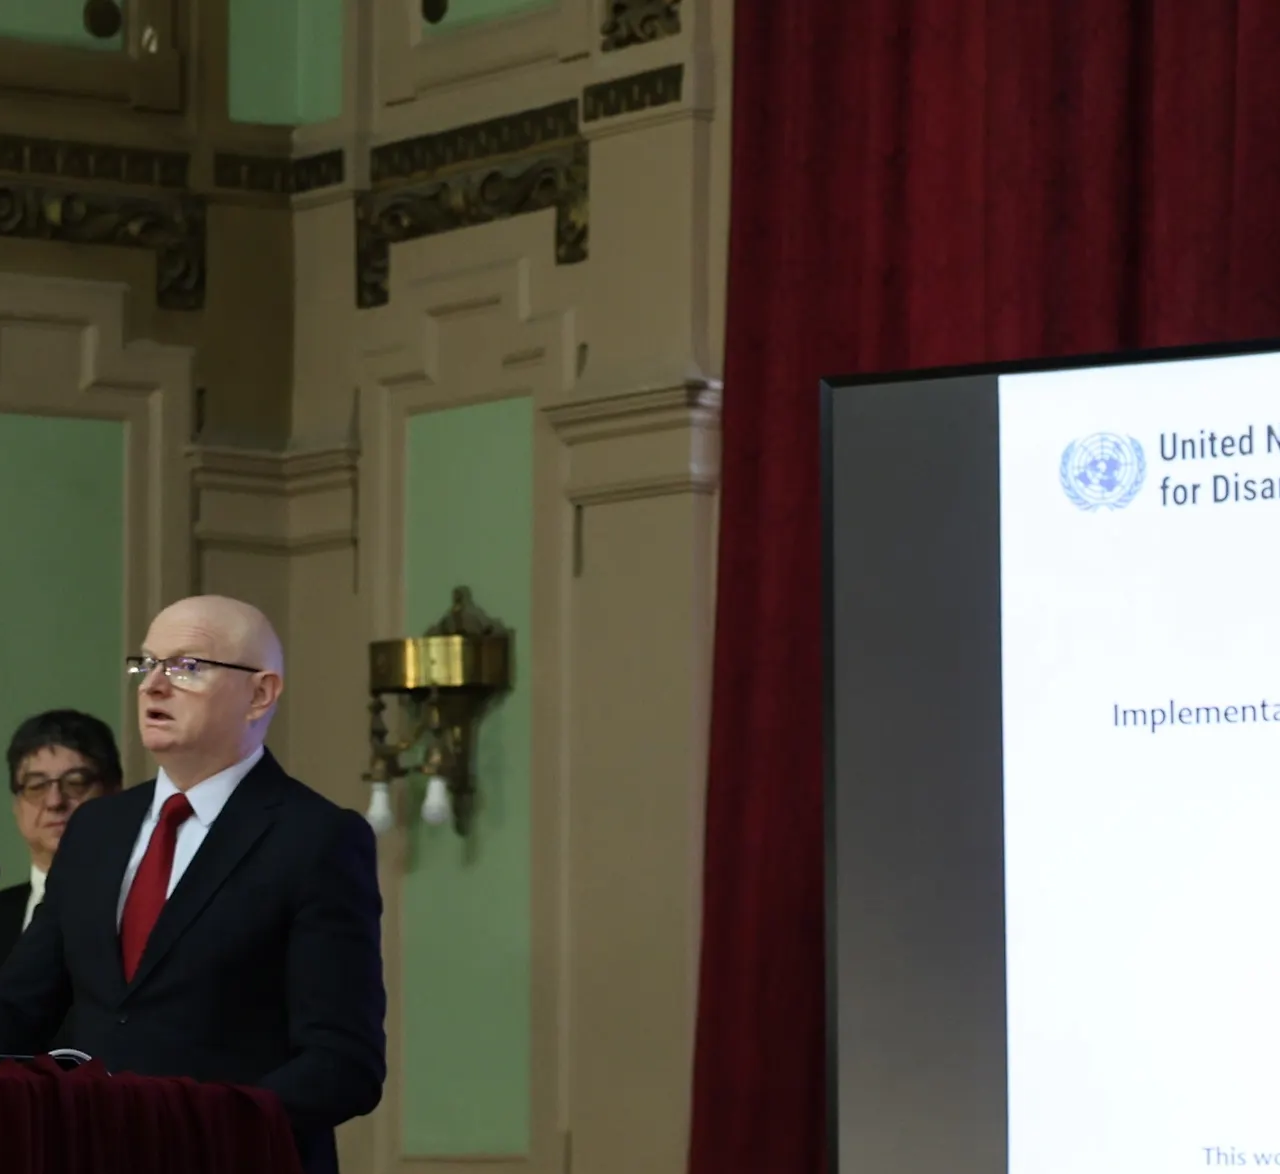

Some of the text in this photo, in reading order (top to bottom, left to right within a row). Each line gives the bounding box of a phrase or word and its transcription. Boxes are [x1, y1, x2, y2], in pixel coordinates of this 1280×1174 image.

[1160, 425, 1254, 462] United
[1160, 476, 1201, 507] for
[1203, 1147, 1247, 1167] This
